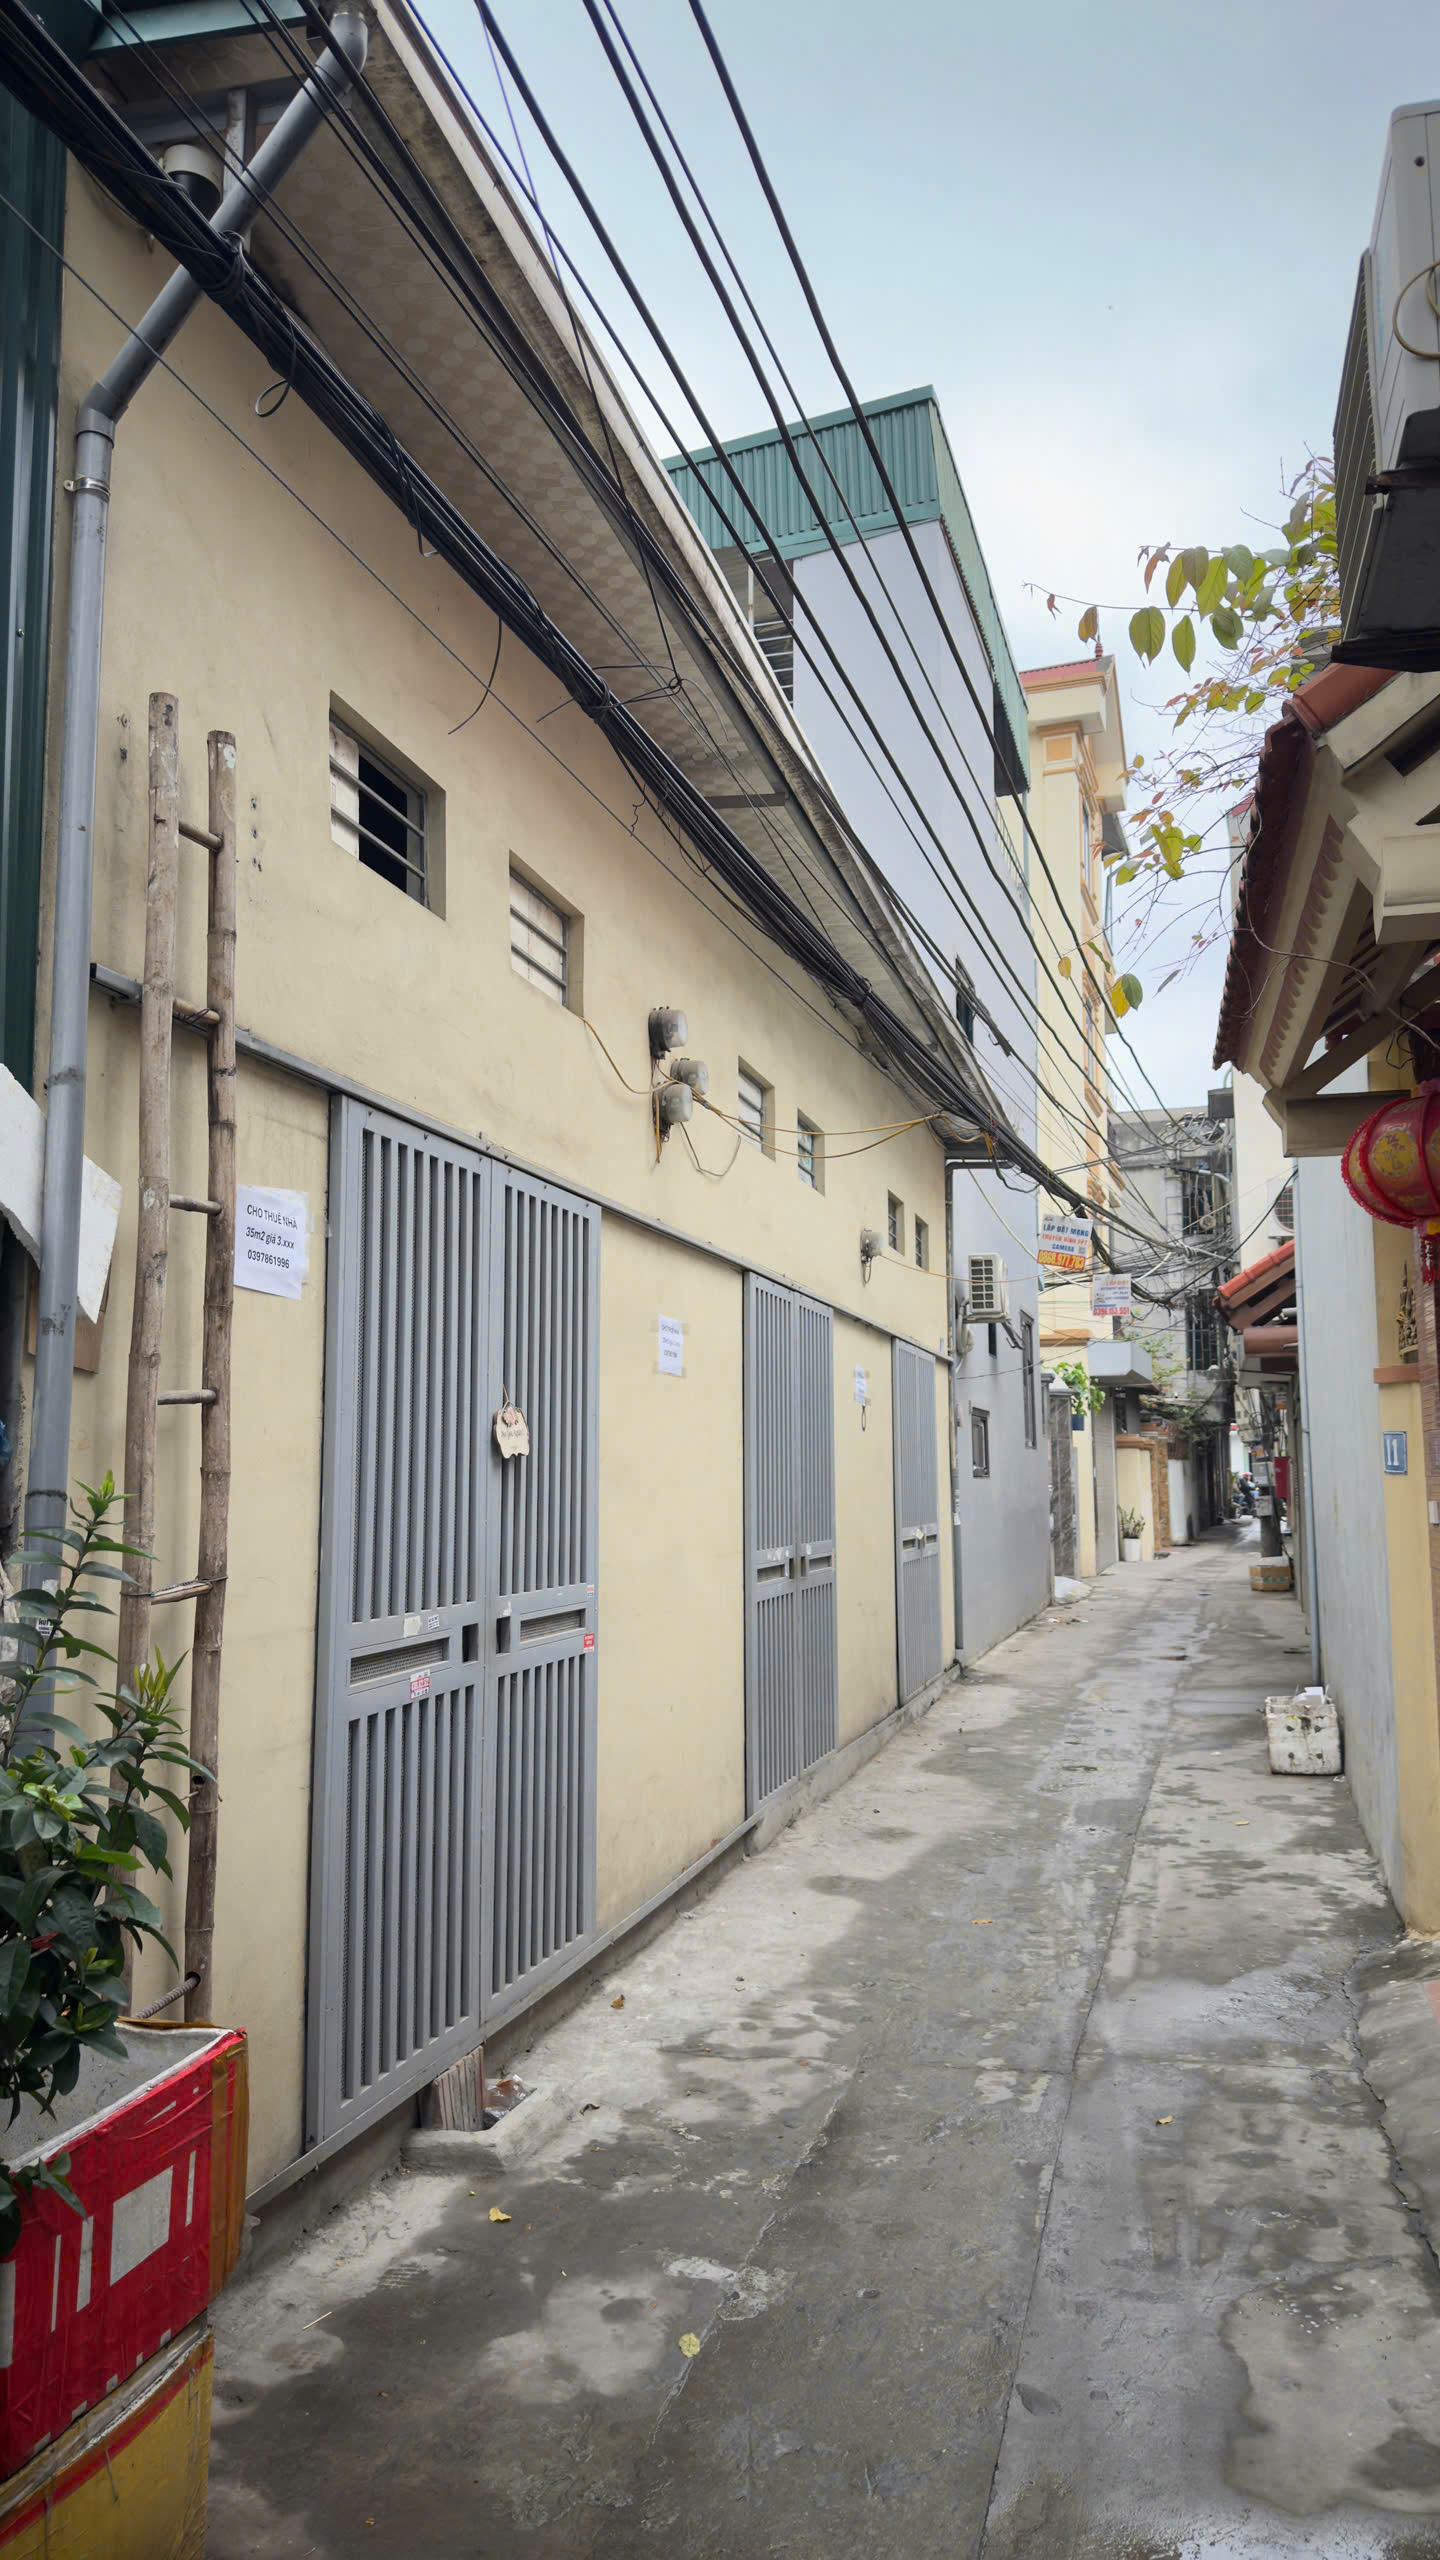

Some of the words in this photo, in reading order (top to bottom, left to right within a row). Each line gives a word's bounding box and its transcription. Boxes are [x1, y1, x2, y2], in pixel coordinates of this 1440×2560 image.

[247, 1204, 263, 1218] CHO
[264, 1209, 282, 1225] THUÊ
[282, 1215, 298, 1230] NHÀ
[245, 1226, 265, 1241] 35m2
[265, 1232, 276, 1245] giá
[1051, 1243, 1074, 1252] CAMERA
[247, 1249, 290, 1269] 0397861996
[1386, 1438, 1399, 1466] 11
